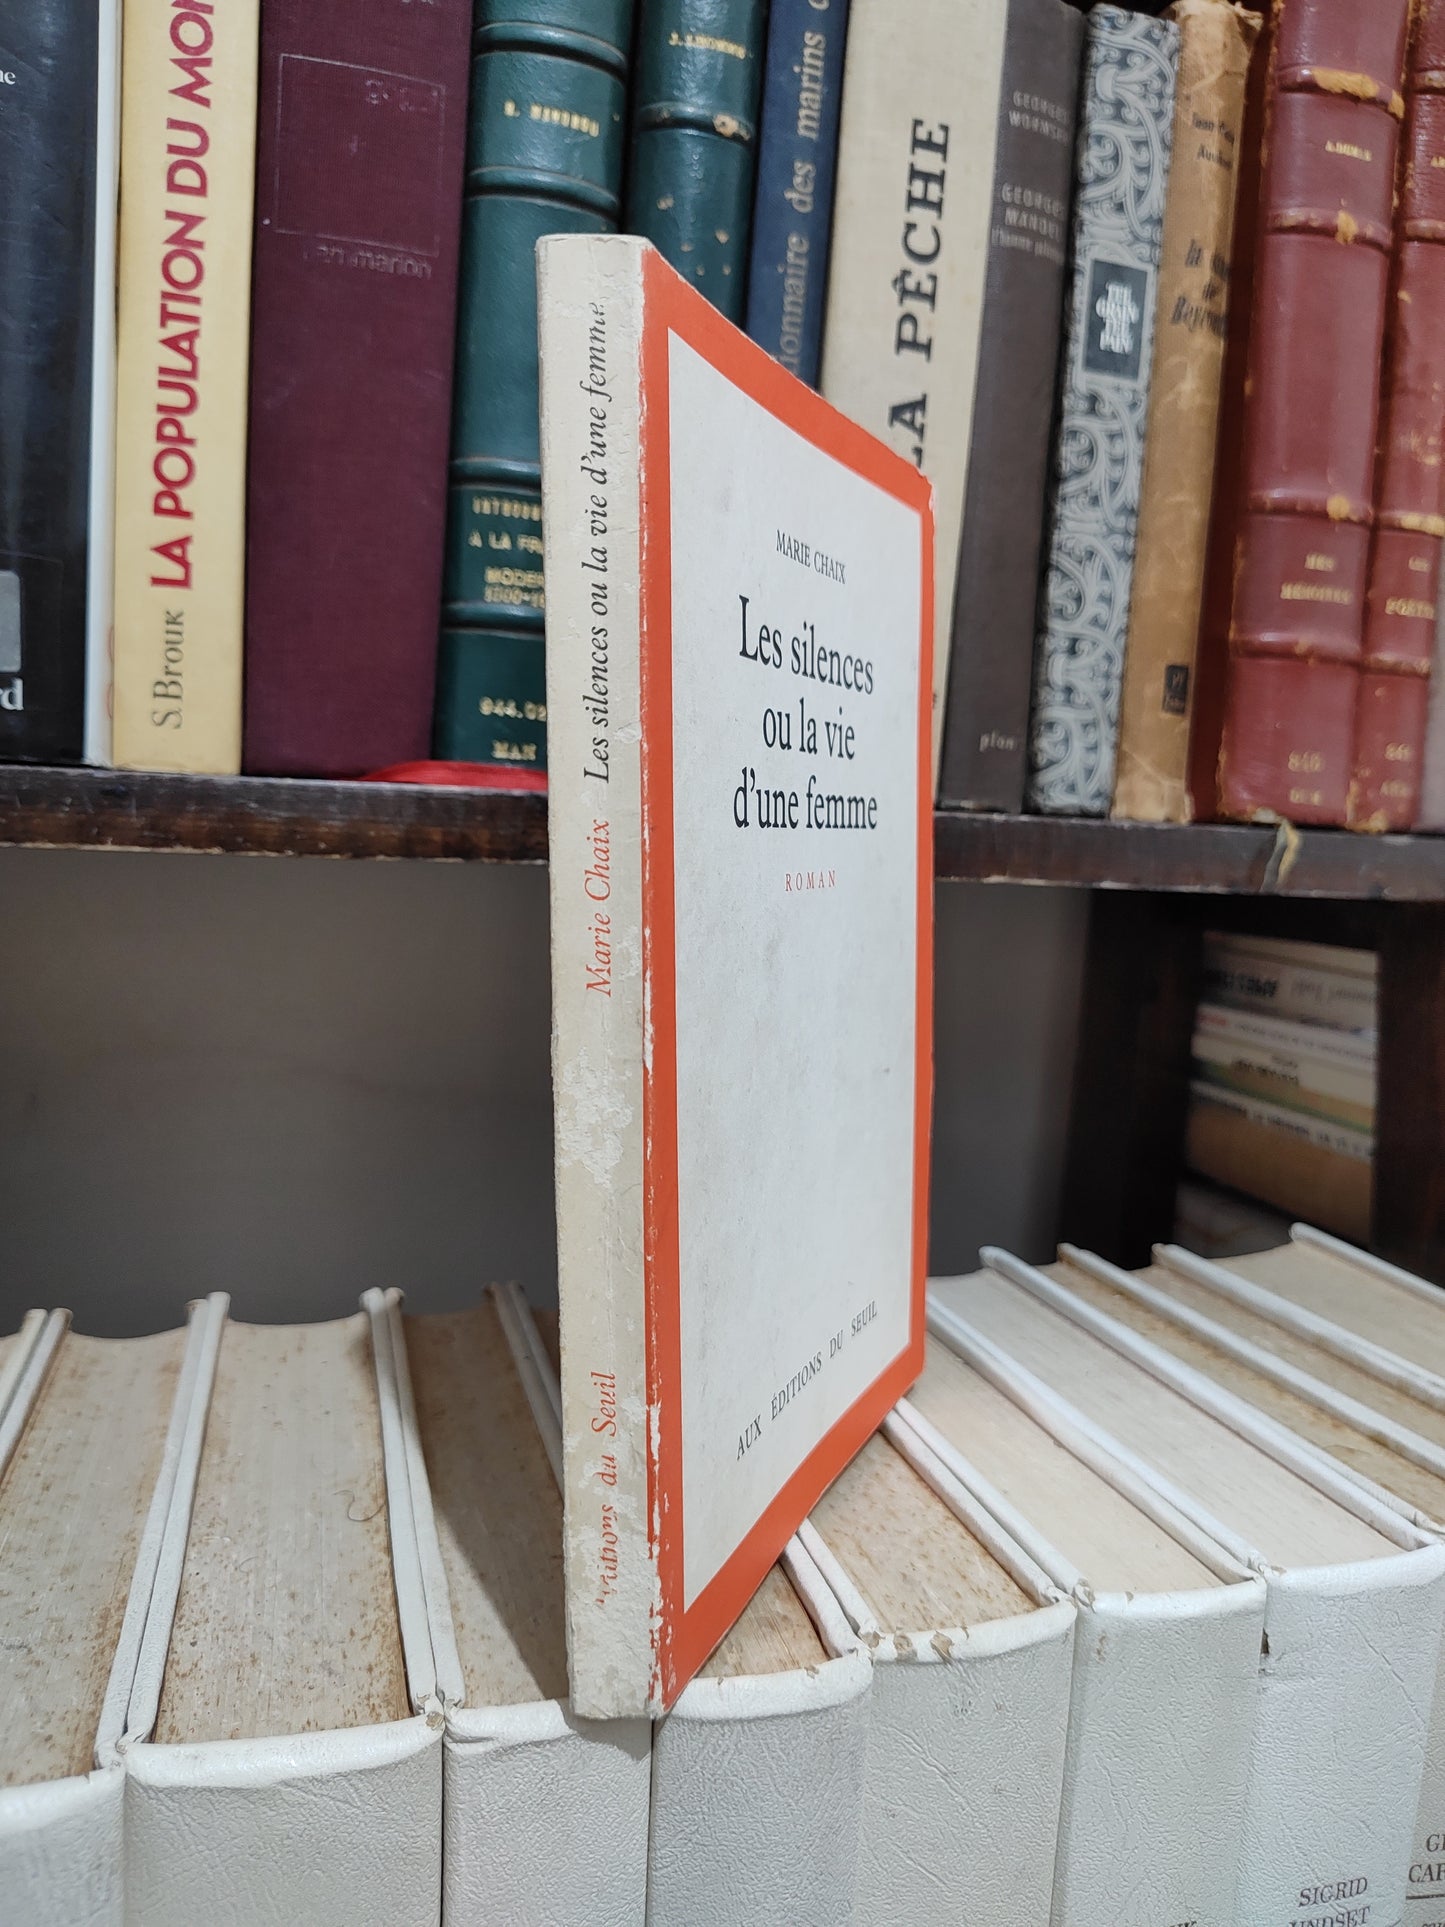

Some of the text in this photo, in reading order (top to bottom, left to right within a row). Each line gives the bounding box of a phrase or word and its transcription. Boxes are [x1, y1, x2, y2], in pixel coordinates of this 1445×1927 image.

[793, 30, 826, 140] marins
[166, 117, 210, 198] DU
[784, 161, 816, 213] des
[891, 118, 949, 362] PÊCHE
[153, 210, 207, 520] POPULATION
[581, 407, 607, 485] d'une
[585, 495, 608, 536] vie
[150, 535, 193, 589] LA
[582, 547, 608, 572] la
[776, 529, 846, 585] MARIE CHAIX
[591, 583, 608, 616] ou
[739, 594, 874, 694] Les silences
[583, 626, 609, 728] silences
[584, 737, 610, 784] Les
[762, 697, 855, 760] ou la vie
[733, 766, 878, 830] d'une femme
[584, 819, 612, 998] Marie Chaix
[785, 870, 836, 892] ROMAN
[591, 1371, 617, 1437] Seuil
[737, 1300, 878, 1461] AUX ÉDITIONS DU SEUIL
[1299, 1876, 1369, 1908] SIGRID
